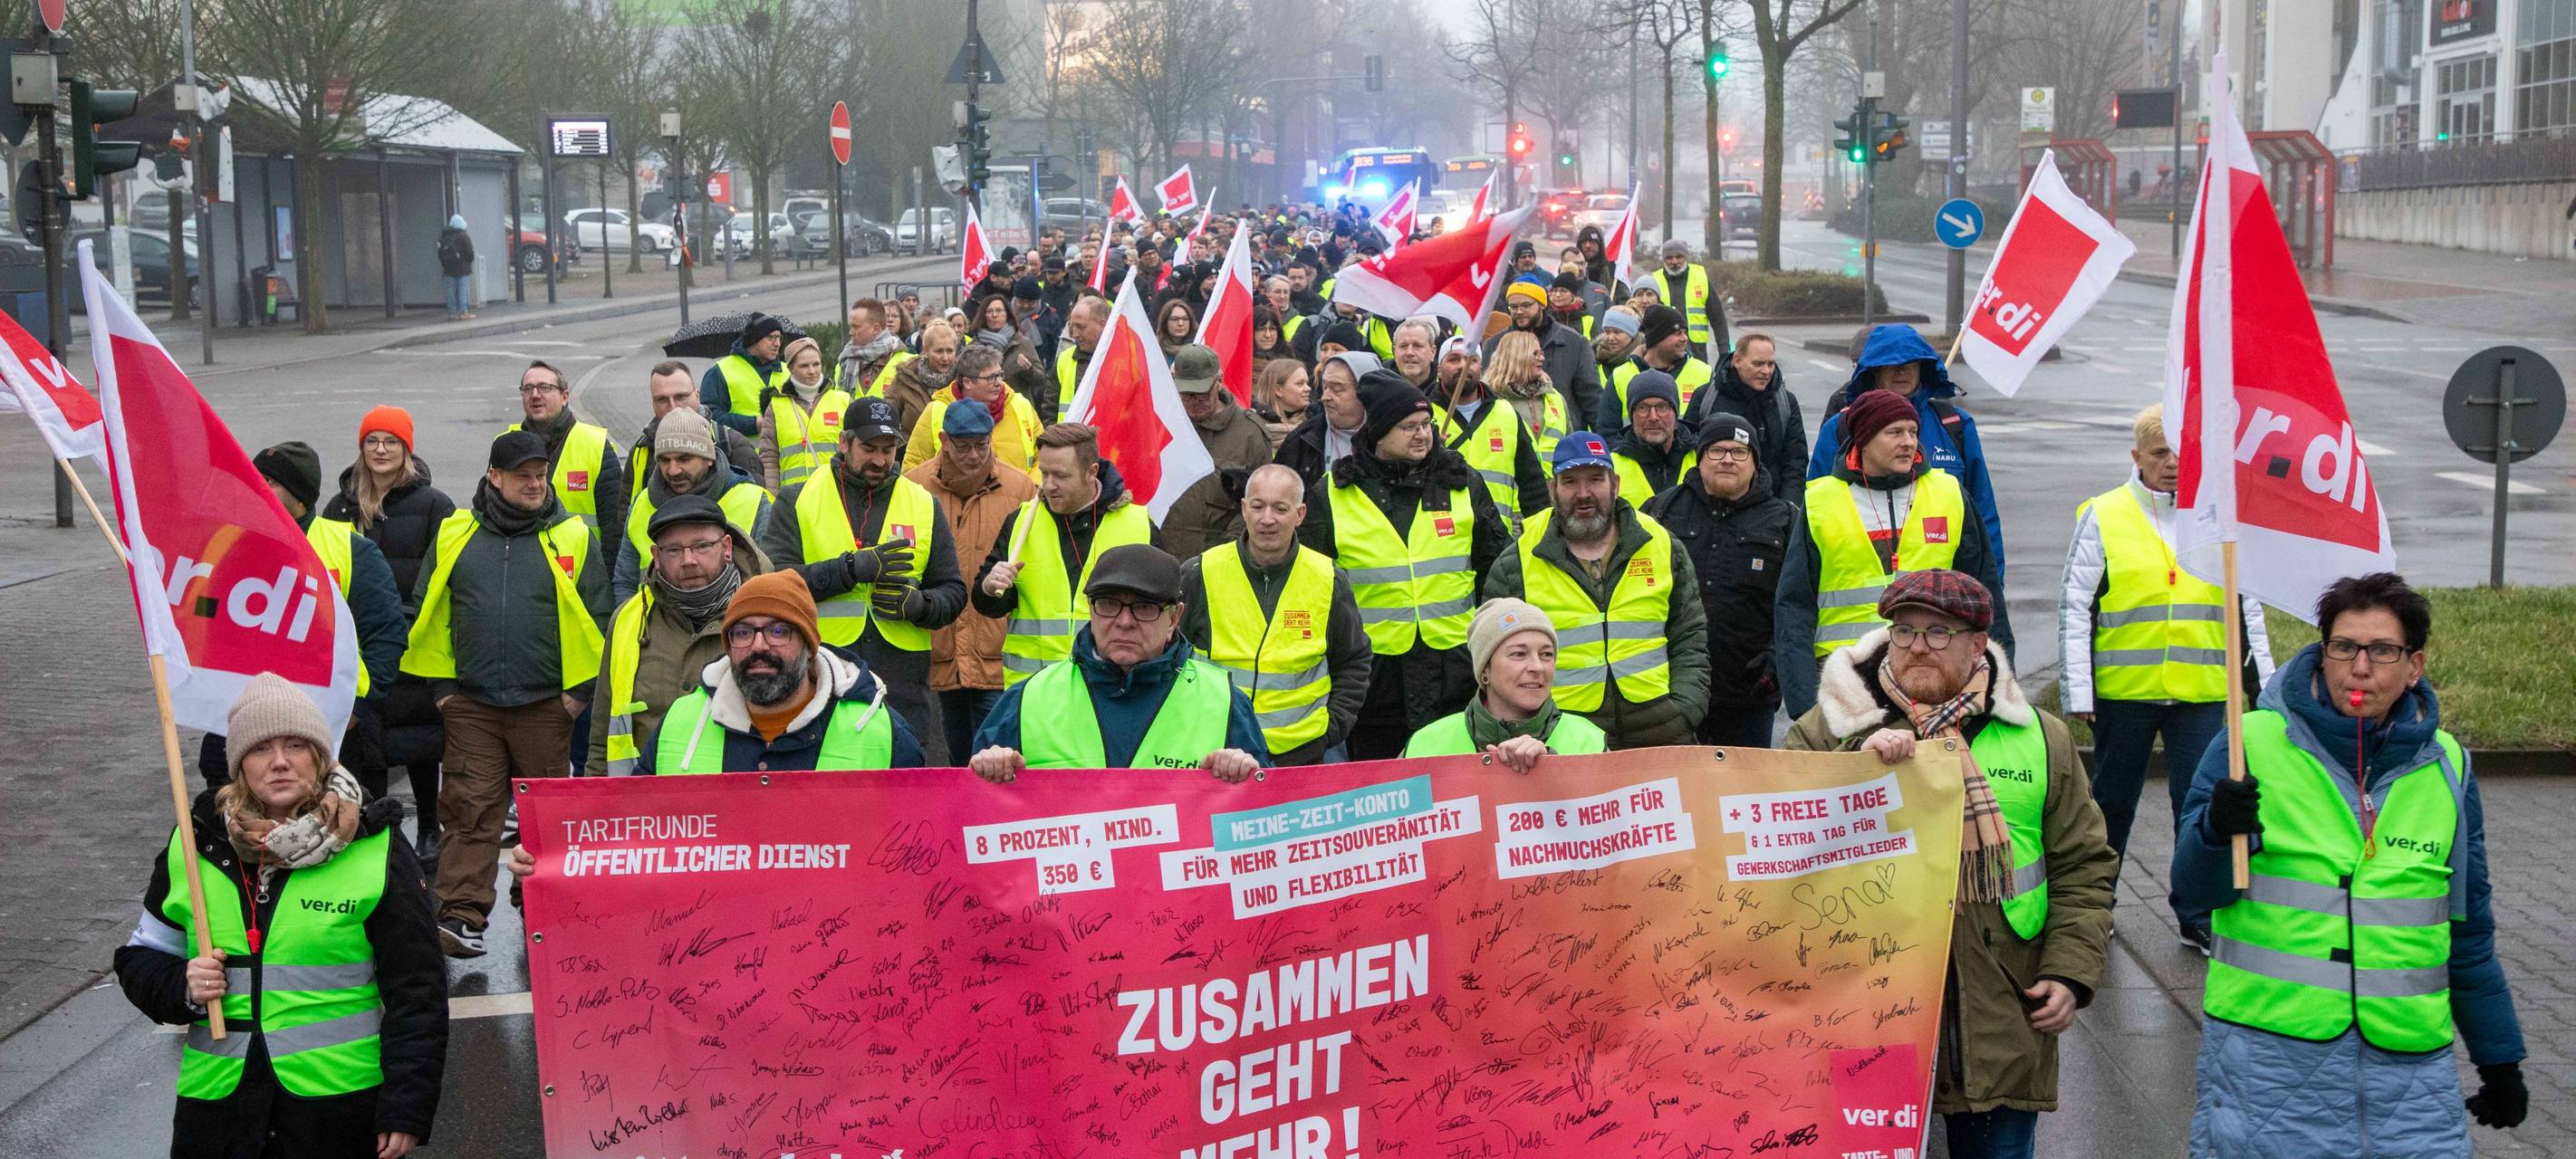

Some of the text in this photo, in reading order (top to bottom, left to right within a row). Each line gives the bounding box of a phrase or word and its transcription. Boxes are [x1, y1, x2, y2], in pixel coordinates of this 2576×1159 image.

[1981, 279, 2042, 340] er.di
[1926, 532, 1946, 541] ver.di
[1154, 754, 1201, 769] ver.d
[1987, 768, 2032, 782] ver.di
[1231, 789, 1410, 842] MEINE-ZEIT-KONTO
[1509, 788, 1665, 832] 200 € MEHR FÜR
[1751, 803, 1762, 823] 3
[1771, 799, 1829, 822] FREIE
[1839, 786, 1889, 813] TAGE
[562, 815, 717, 843] TARIFRUNDE
[976, 817, 1163, 856] 8 PROZENT, MIND.
[1183, 809, 1462, 882] FÜR MEHR ZEITSOUVERÄNITÄT
[1509, 822, 1677, 867] NACHWUCHSKRÄFTE
[1752, 819, 1877, 848] & 1 EXTRA TAG FÜR
[2384, 836, 2440, 857] ver.di
[563, 844, 851, 877] ÖFFENTLICHER DIENST
[1043, 860, 1102, 886] 350 €
[1737, 837, 1908, 876] GEWERKSCHAFTSMITGLIEDER
[1244, 853, 1418, 908] UND FLEXIBILITÄT
[300, 898, 357, 915] ver.di
[1792, 879, 1895, 931] Sena
[1117, 934, 1429, 1056] ZUSAMMEN
[1200, 1030, 1351, 1125] GEHT
[1180, 1106, 1360, 1159] HR!
[1842, 1104, 1918, 1128] ver.di
